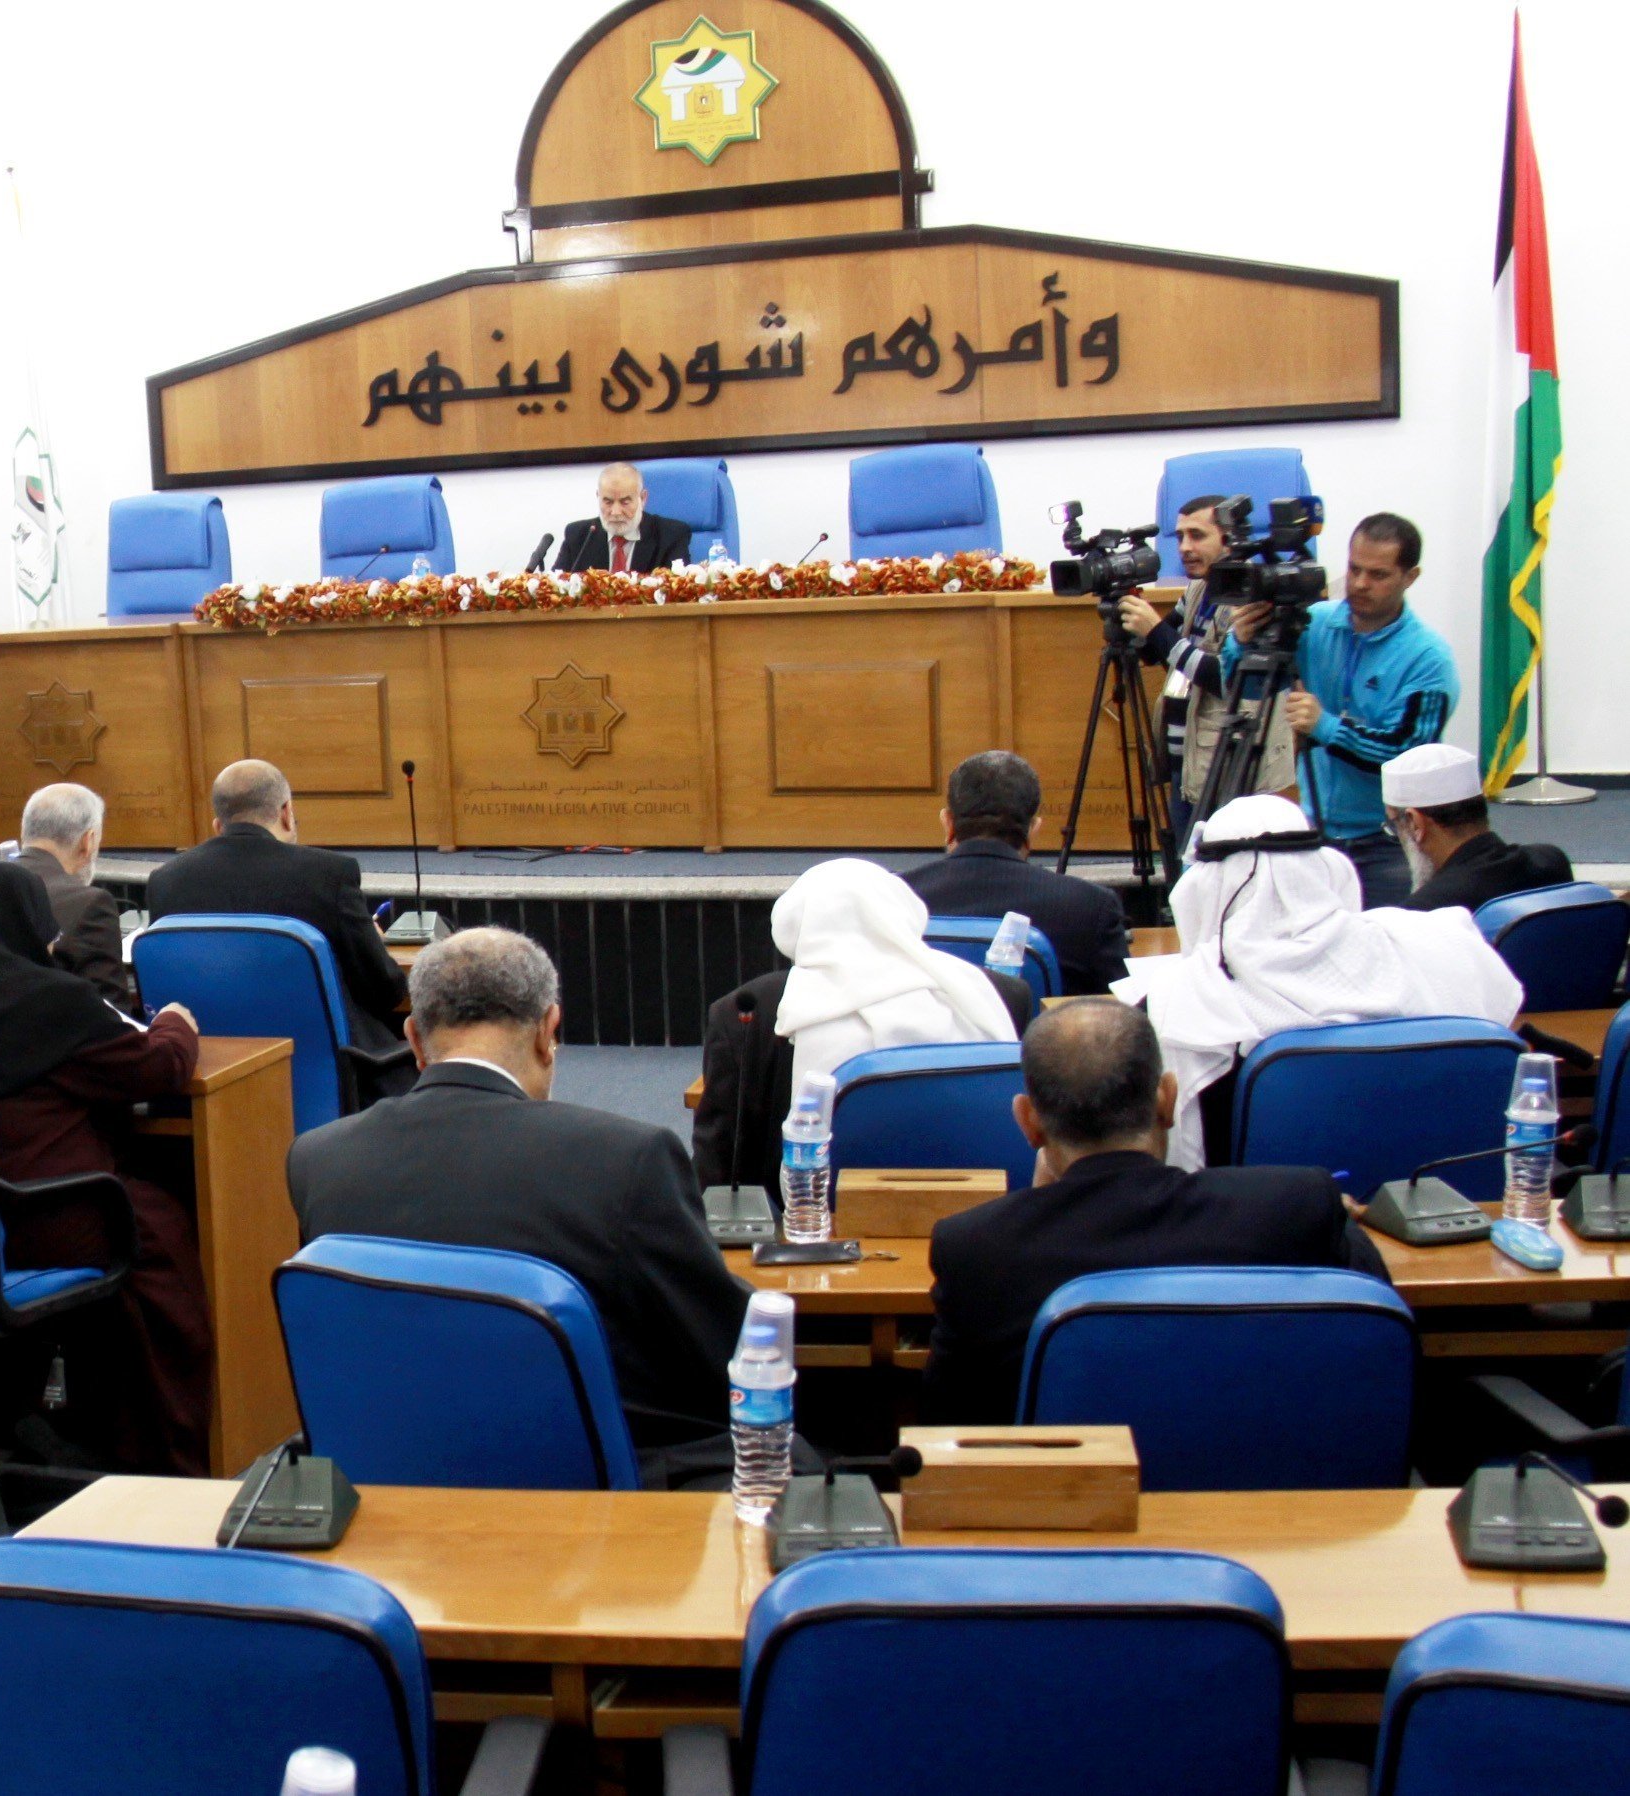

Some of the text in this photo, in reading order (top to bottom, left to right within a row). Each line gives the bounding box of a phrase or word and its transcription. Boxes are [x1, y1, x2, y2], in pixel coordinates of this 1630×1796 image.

[362, 271, 1120, 428] وأمرهم شورى بينهم
[463, 801, 692, 815] PALESTINIAN LEGISLATIVE COUNCIL
